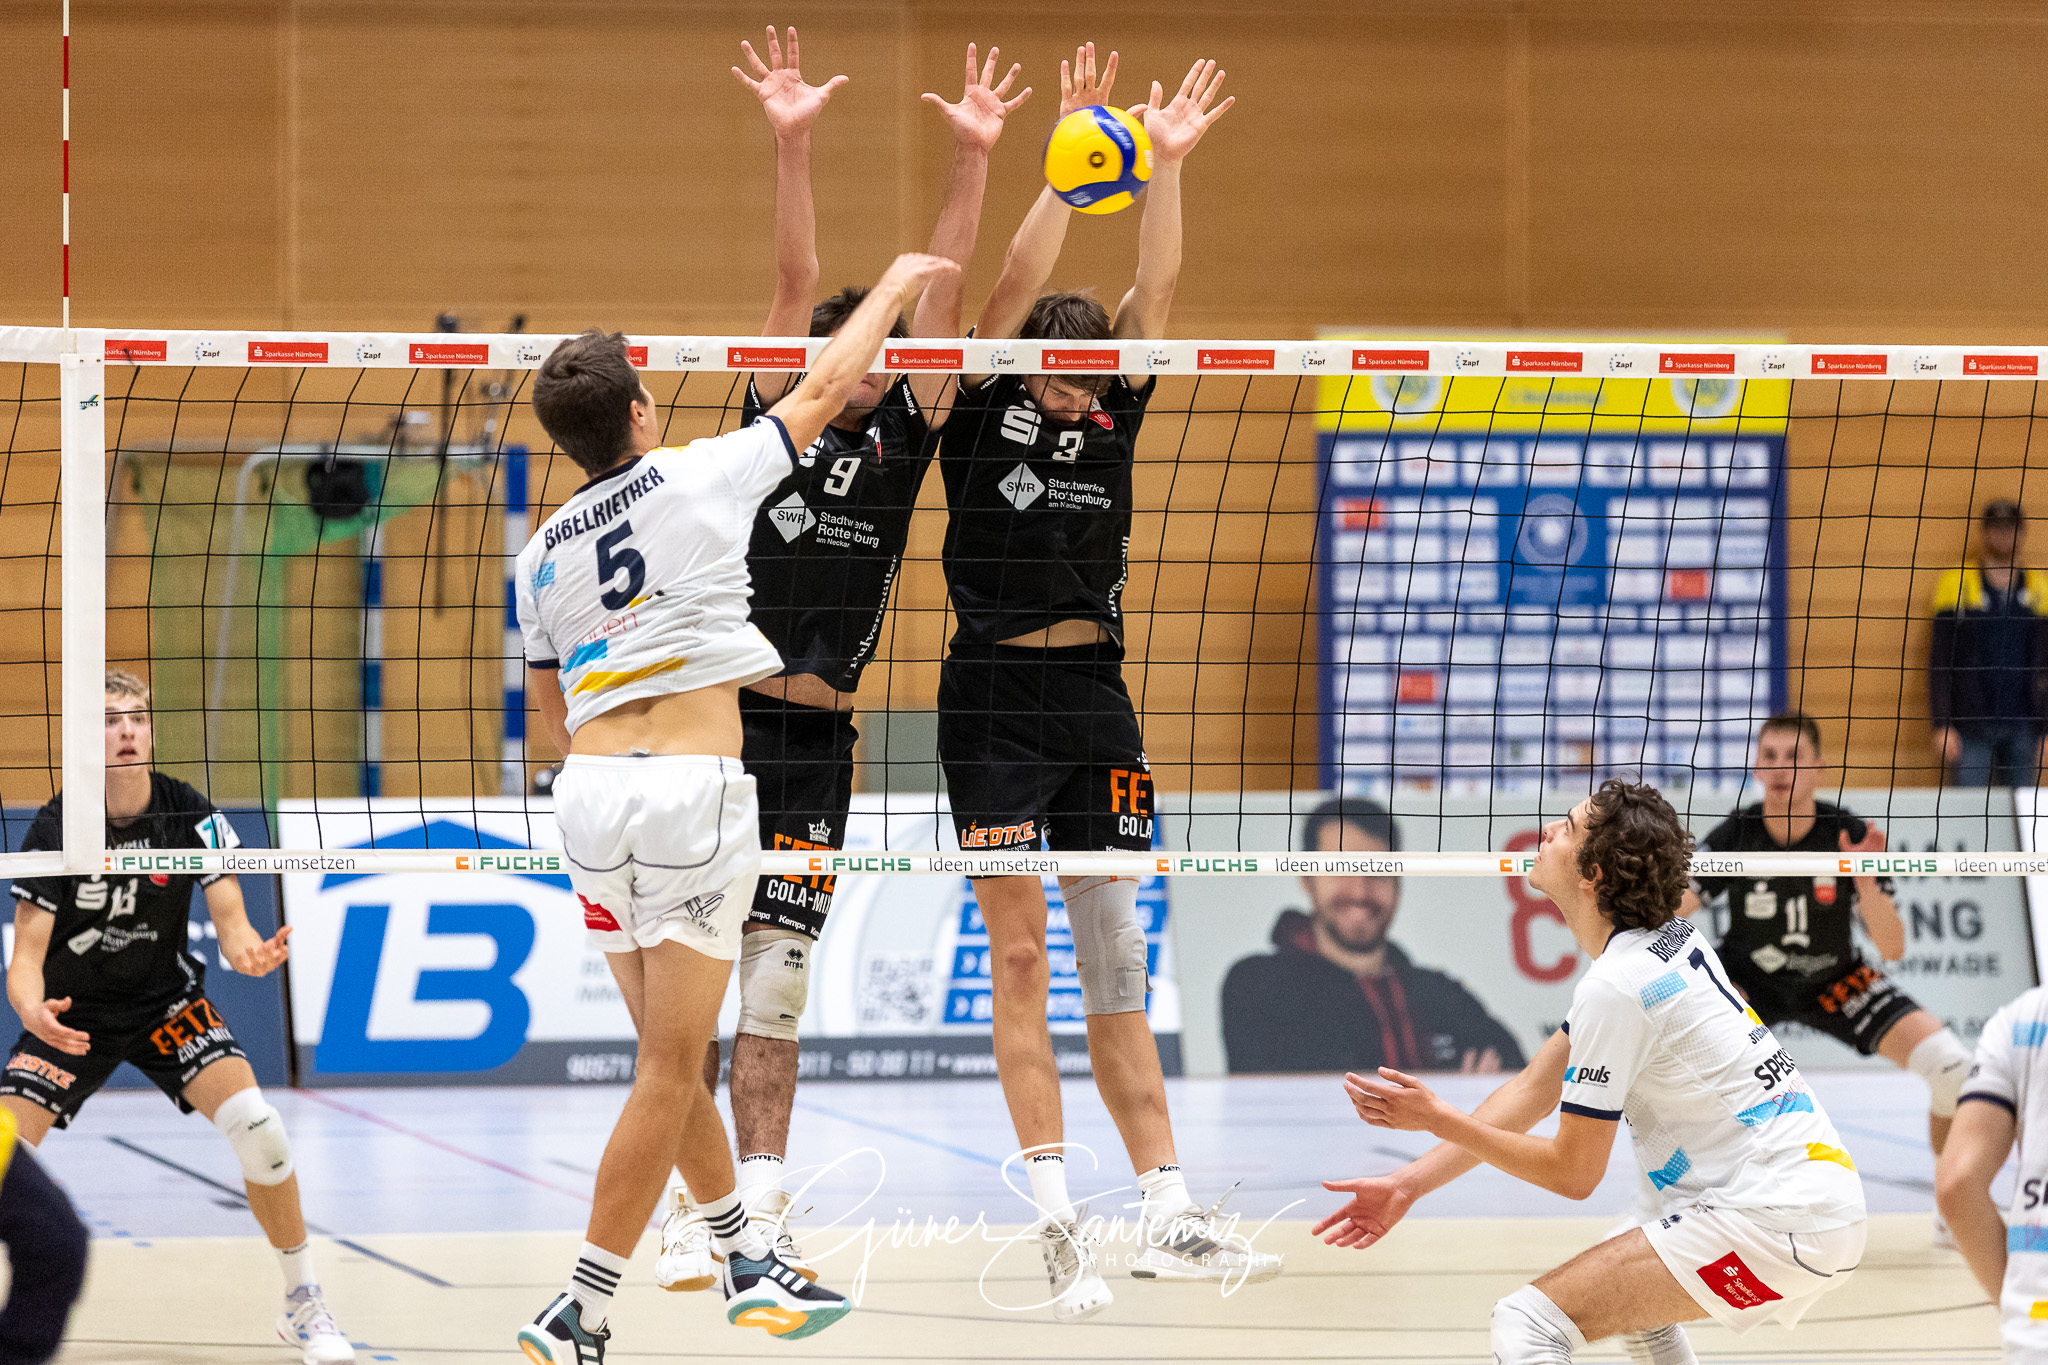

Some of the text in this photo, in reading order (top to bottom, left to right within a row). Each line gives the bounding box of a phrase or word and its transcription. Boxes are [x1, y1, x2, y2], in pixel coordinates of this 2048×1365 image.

[133, 348, 161, 358] Nürnberg
[202, 350, 220, 359] Zapf
[265, 350, 323, 359] Sparkasse Nürnberg
[363, 351, 381, 360] Zapf
[425, 352, 483, 361] Sparkasse Nürnberg
[523, 353, 541, 362] Zapf
[682, 355, 700, 364] Zapf
[744, 355, 801, 365] Sparkasse Nürnberg
[901, 357, 958, 366] Sparkasse Nürnberg
[997, 357, 1015, 366] Zapf
[1058, 357, 1114, 367] Sparkasse Nürnberg
[1153, 358, 1171, 367] Zapf
[1213, 357, 1269, 366] Sparkasse Nürnberg
[1308, 358, 1326, 367] Zapf
[1368, 358, 1424, 367] Sparkasse Nürnberg
[1462, 359, 1480, 368] Zapf
[1522, 359, 1578, 368] Sparkasse Nürnberg
[1615, 360, 1633, 370] Zapf
[1675, 361, 1730, 370] Sparkasse Nürnberg
[1768, 362, 1785, 371] Zapf
[1827, 362, 1882, 371] Sparkasse Nürnberg
[1920, 363, 1937, 372] Zapf
[1979, 363, 2033, 372] Sparkasse Nürnberg
[823, 457, 862, 497] 9
[1006, 482, 1036, 494] SWR
[544, 465, 665, 551] BIBELRIETHER
[776, 510, 807, 525] SWR
[827, 537, 850, 549] Neckar
[595, 519, 646, 611] 5
[122, 854, 356, 871] FUCHS Ideen umsetzen
[480, 856, 560, 871] FUCHS
[832, 857, 1060, 873] FUCHS Ideen umsetzen
[1180, 857, 1404, 873] FUCHS Ideen umsetzen
[1687, 859, 1744, 873] setzen
[1861, 859, 1938, 873] FUCHS
[1954, 858, 1998, 873] Ideen
[778, 914, 806, 931] Kempa
[1577, 1065, 1611, 1084] puls
[741, 1154, 784, 1165] Kempa
